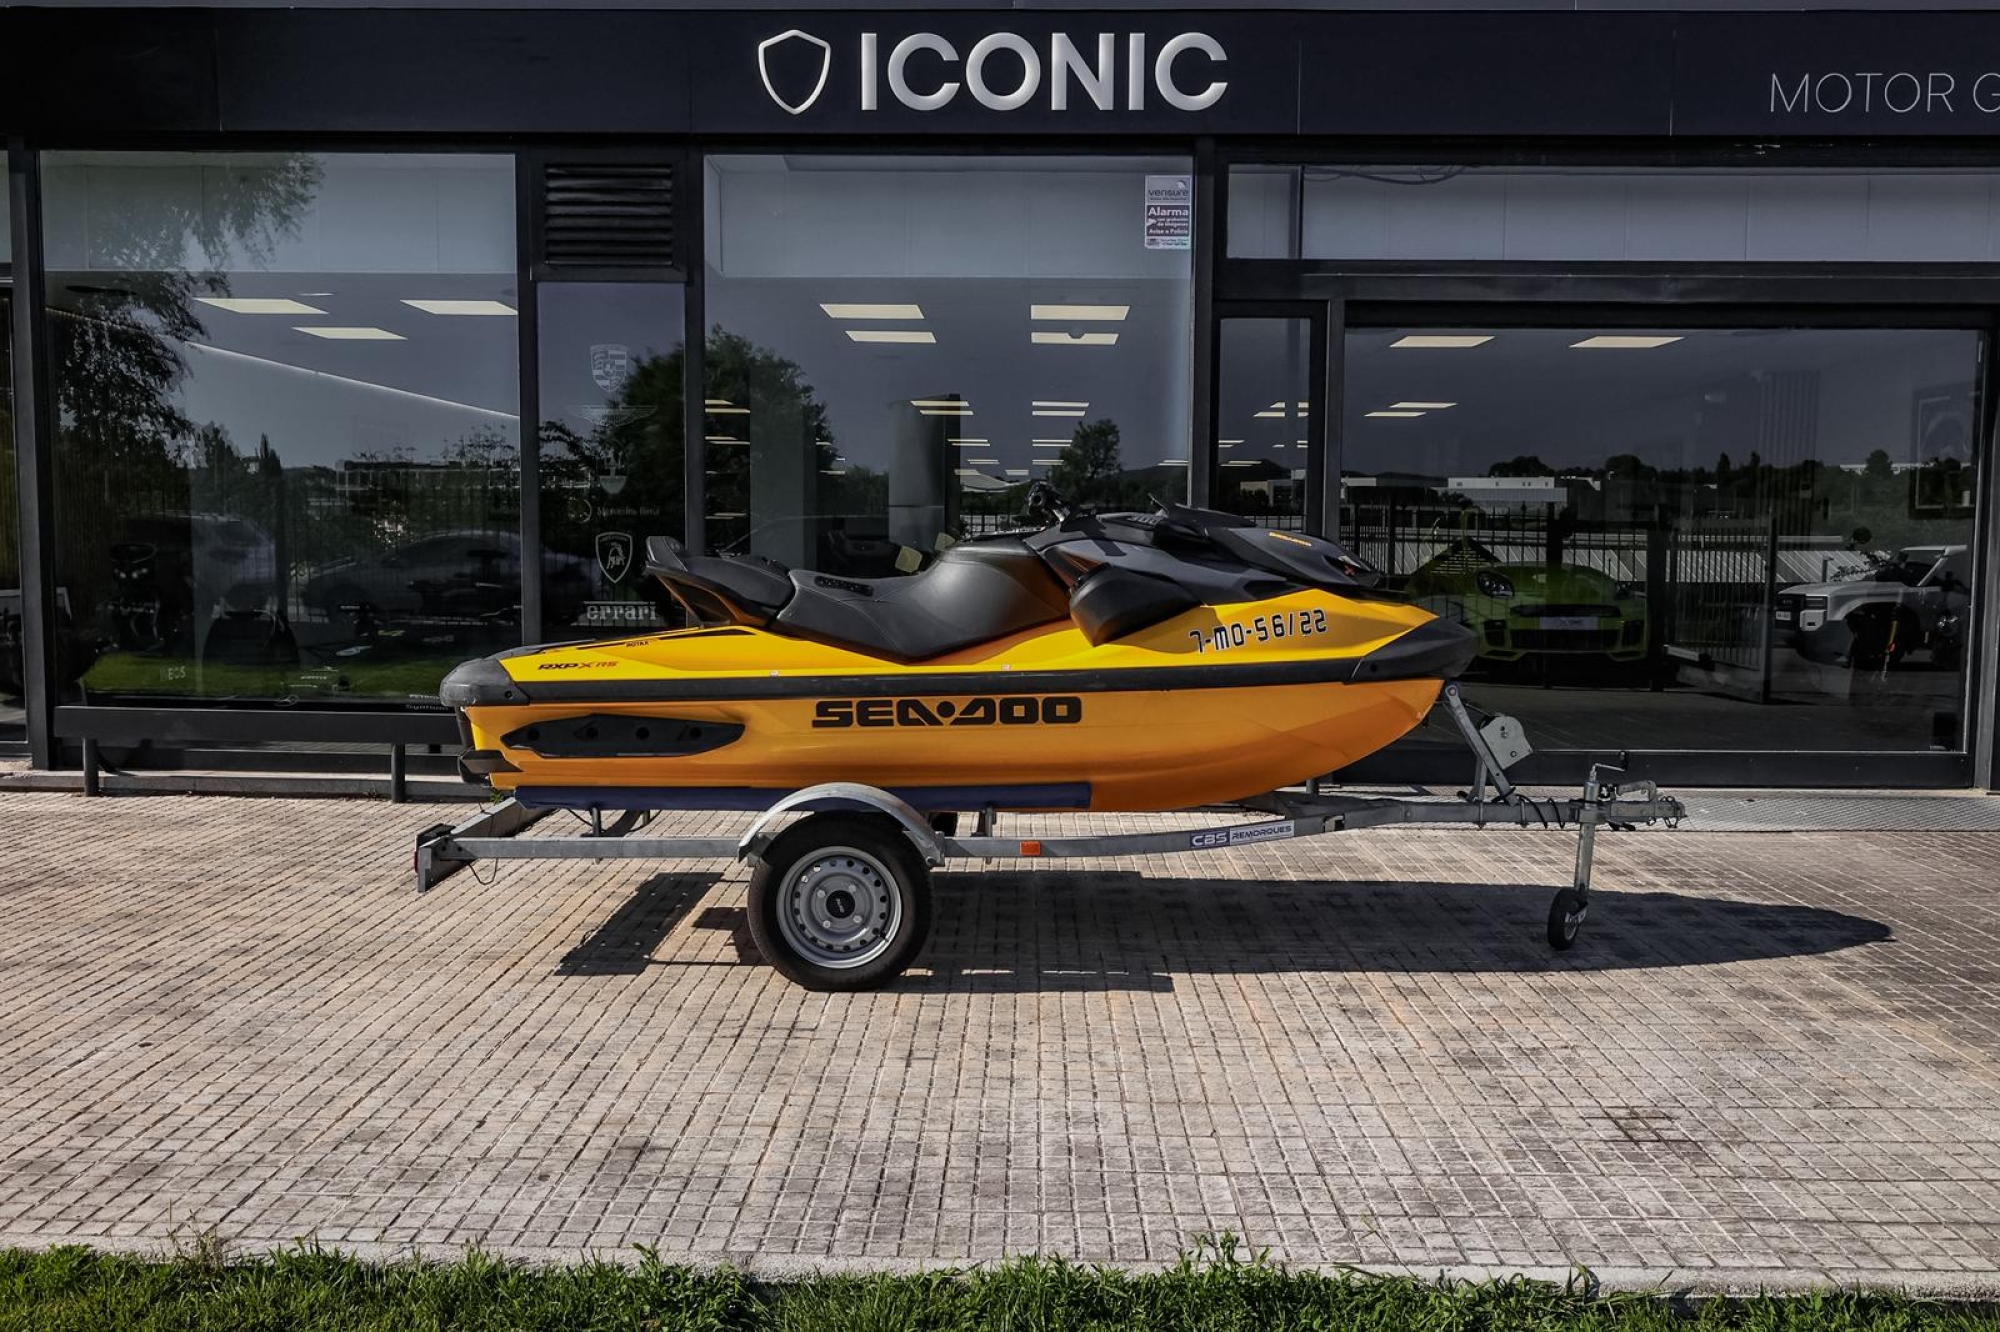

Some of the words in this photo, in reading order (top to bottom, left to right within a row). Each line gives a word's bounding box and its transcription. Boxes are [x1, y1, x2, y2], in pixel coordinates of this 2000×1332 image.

[861, 32, 1228, 111] ICONIC
[1770, 72, 1954, 113] MOTOR
[1148, 206, 1189, 216] Alarma
[1191, 831, 1228, 846] CBS
[1232, 825, 1292, 840] REMORQUES
